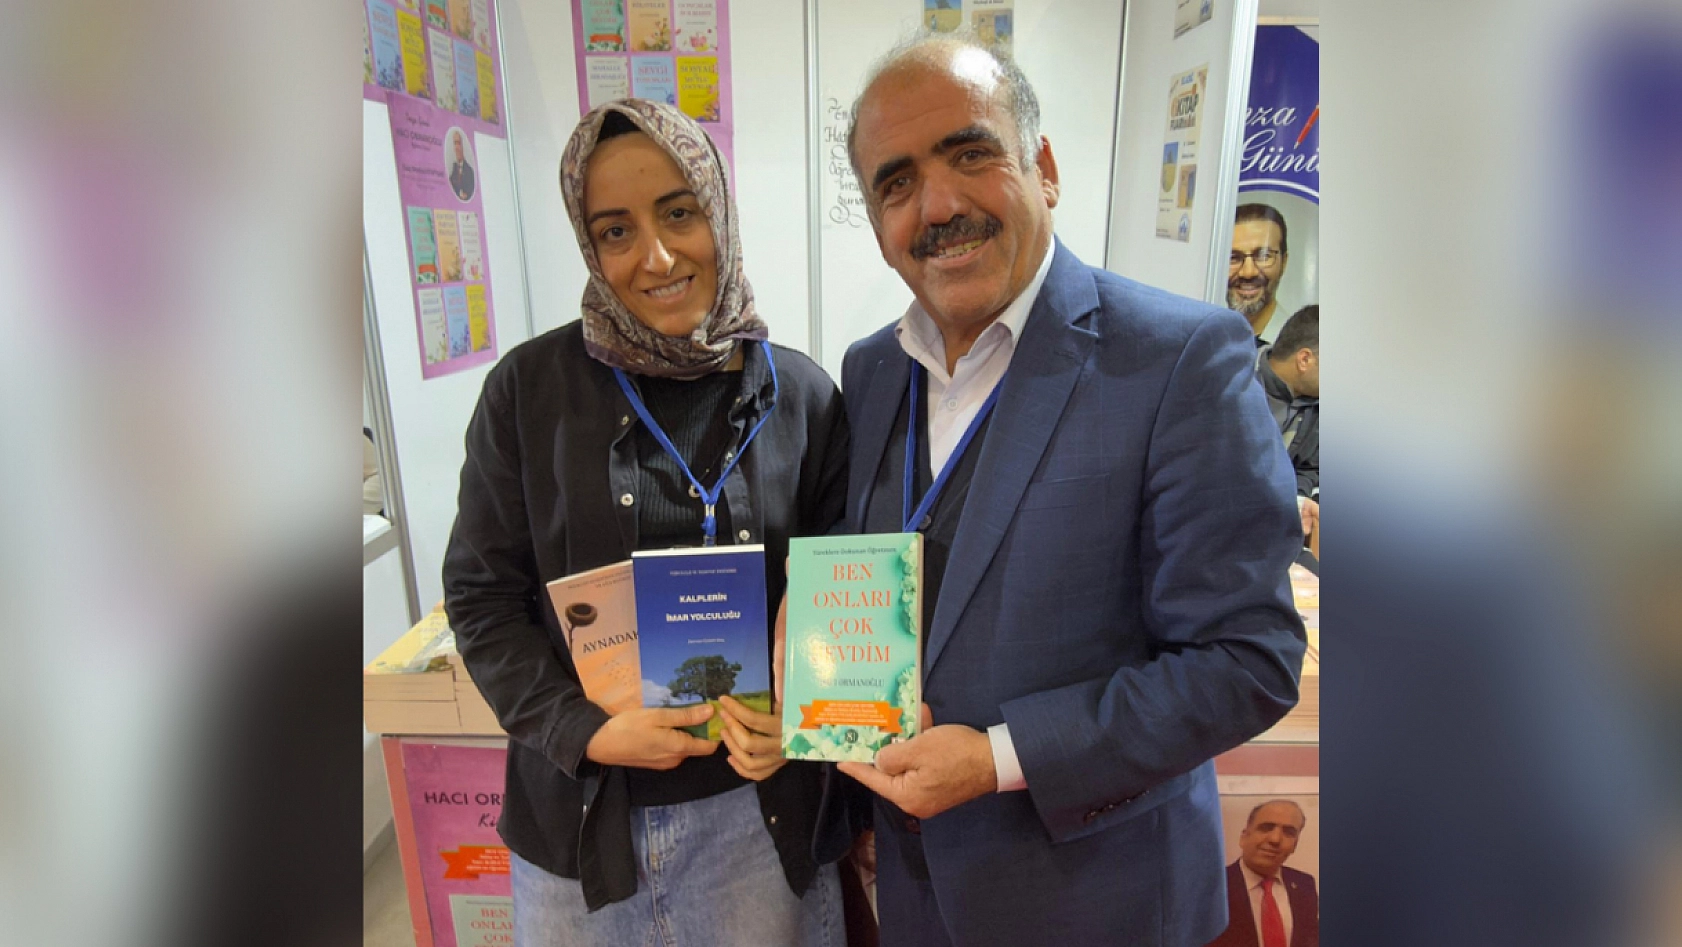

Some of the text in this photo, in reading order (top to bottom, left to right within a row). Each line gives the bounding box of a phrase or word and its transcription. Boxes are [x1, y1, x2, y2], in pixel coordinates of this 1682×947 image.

[833, 563, 873, 581] BEN
[679, 592, 727, 603] KALPLERİN
[813, 590, 891, 608] ONLARI
[666, 610, 741, 622] İMAR YOLCULUĞU
[829, 617, 874, 640] ÇOK
[813, 641, 890, 663] EVDİM
[424, 791, 506, 806] HACI OR
[478, 812, 498, 828] Ki
[480, 908, 508, 918] BEN
